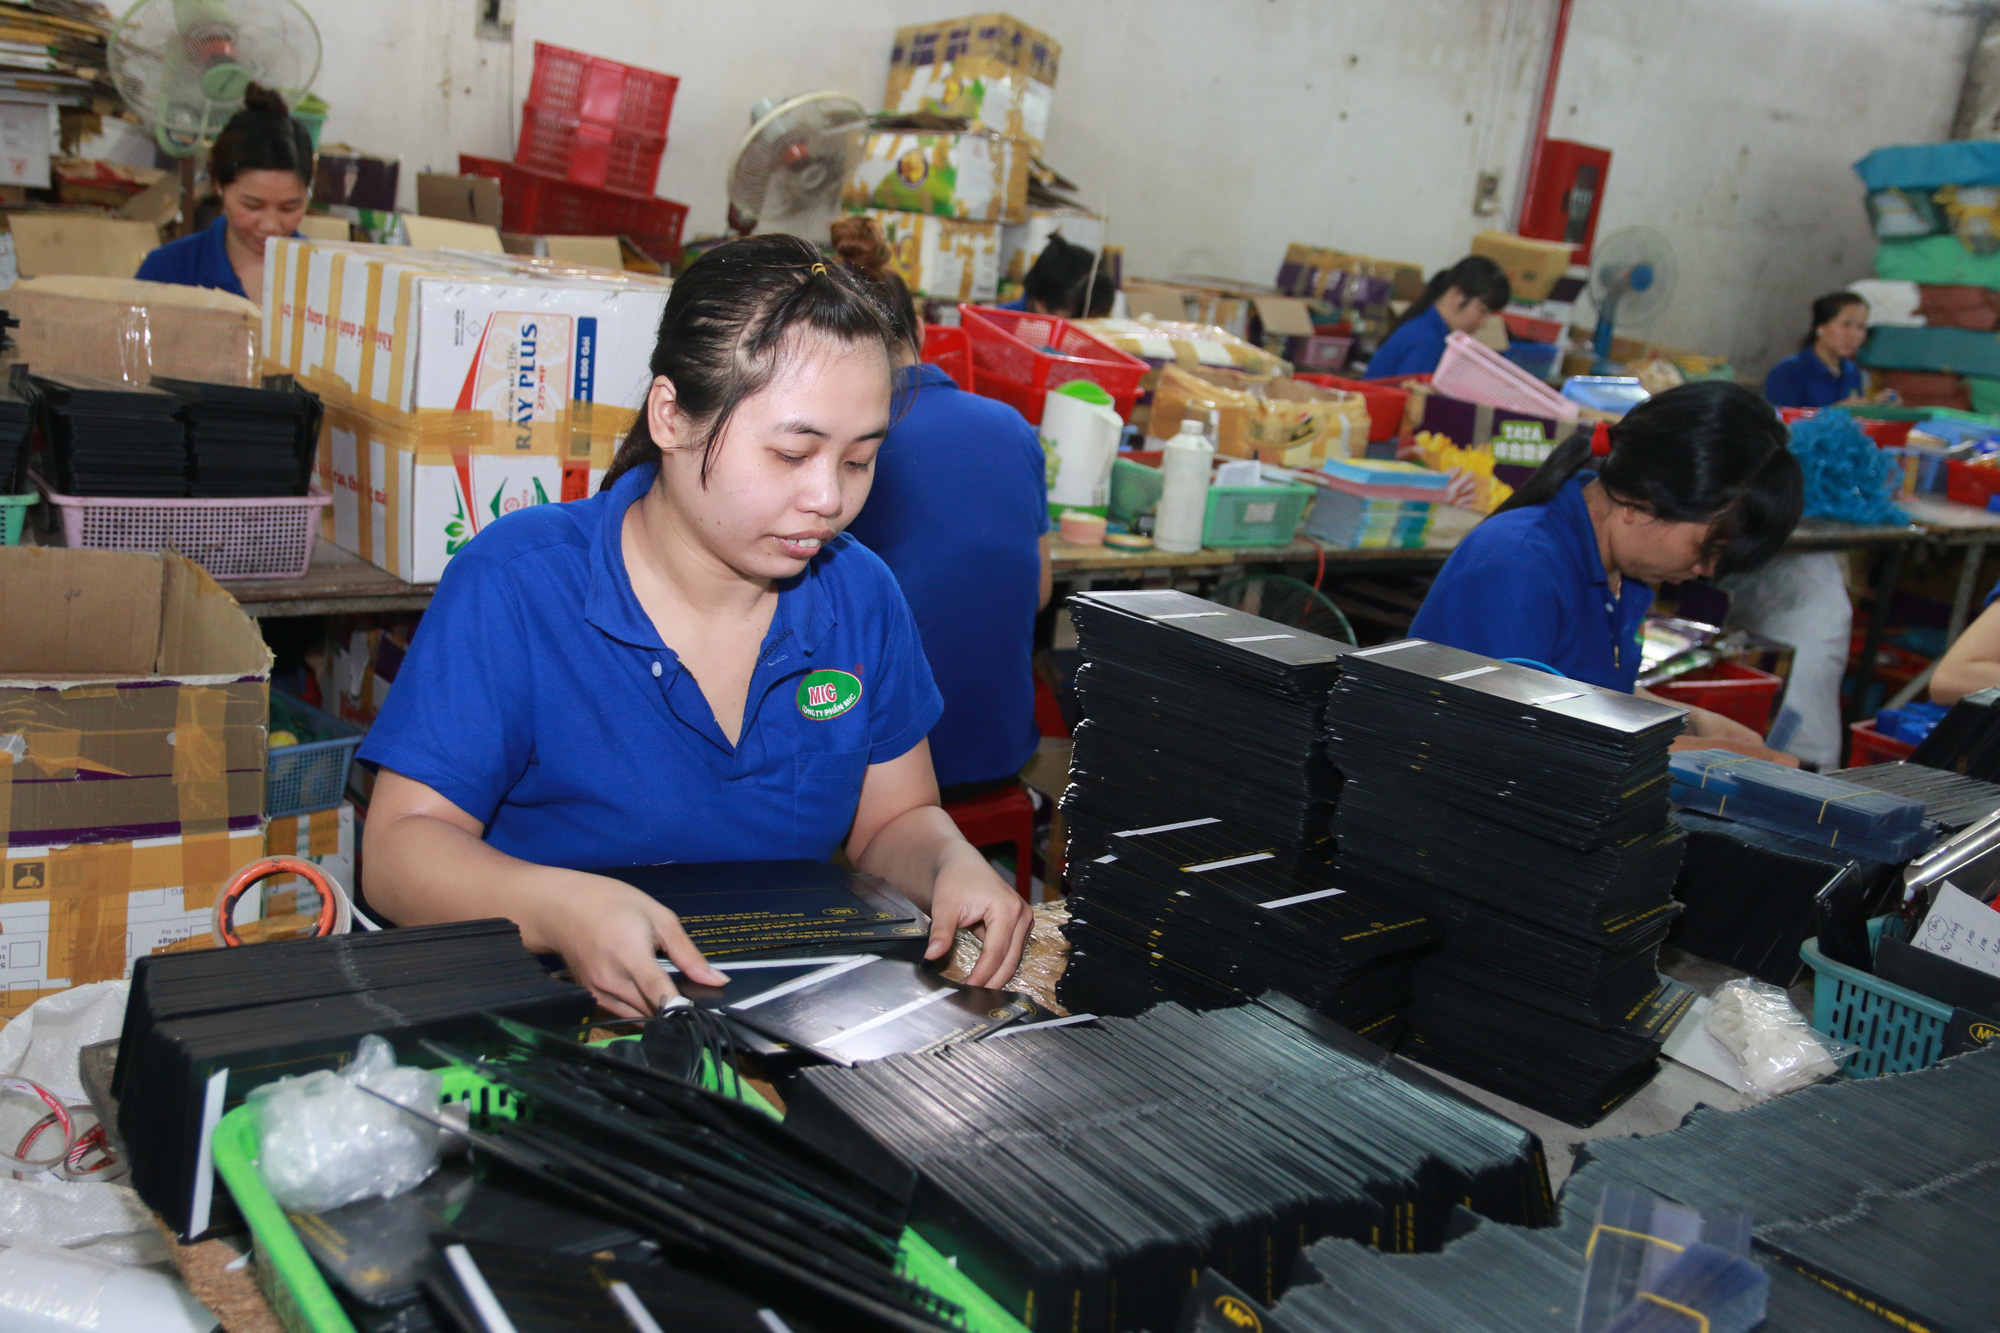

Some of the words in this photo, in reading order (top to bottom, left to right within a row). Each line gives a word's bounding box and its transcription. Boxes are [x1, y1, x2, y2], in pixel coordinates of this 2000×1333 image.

[507, 342, 518, 370] Effe
[519, 323, 538, 389] PLUS
[516, 397, 533, 450] RAY
[808, 683, 837, 706] MIC
[843, 693, 857, 707] MIC
